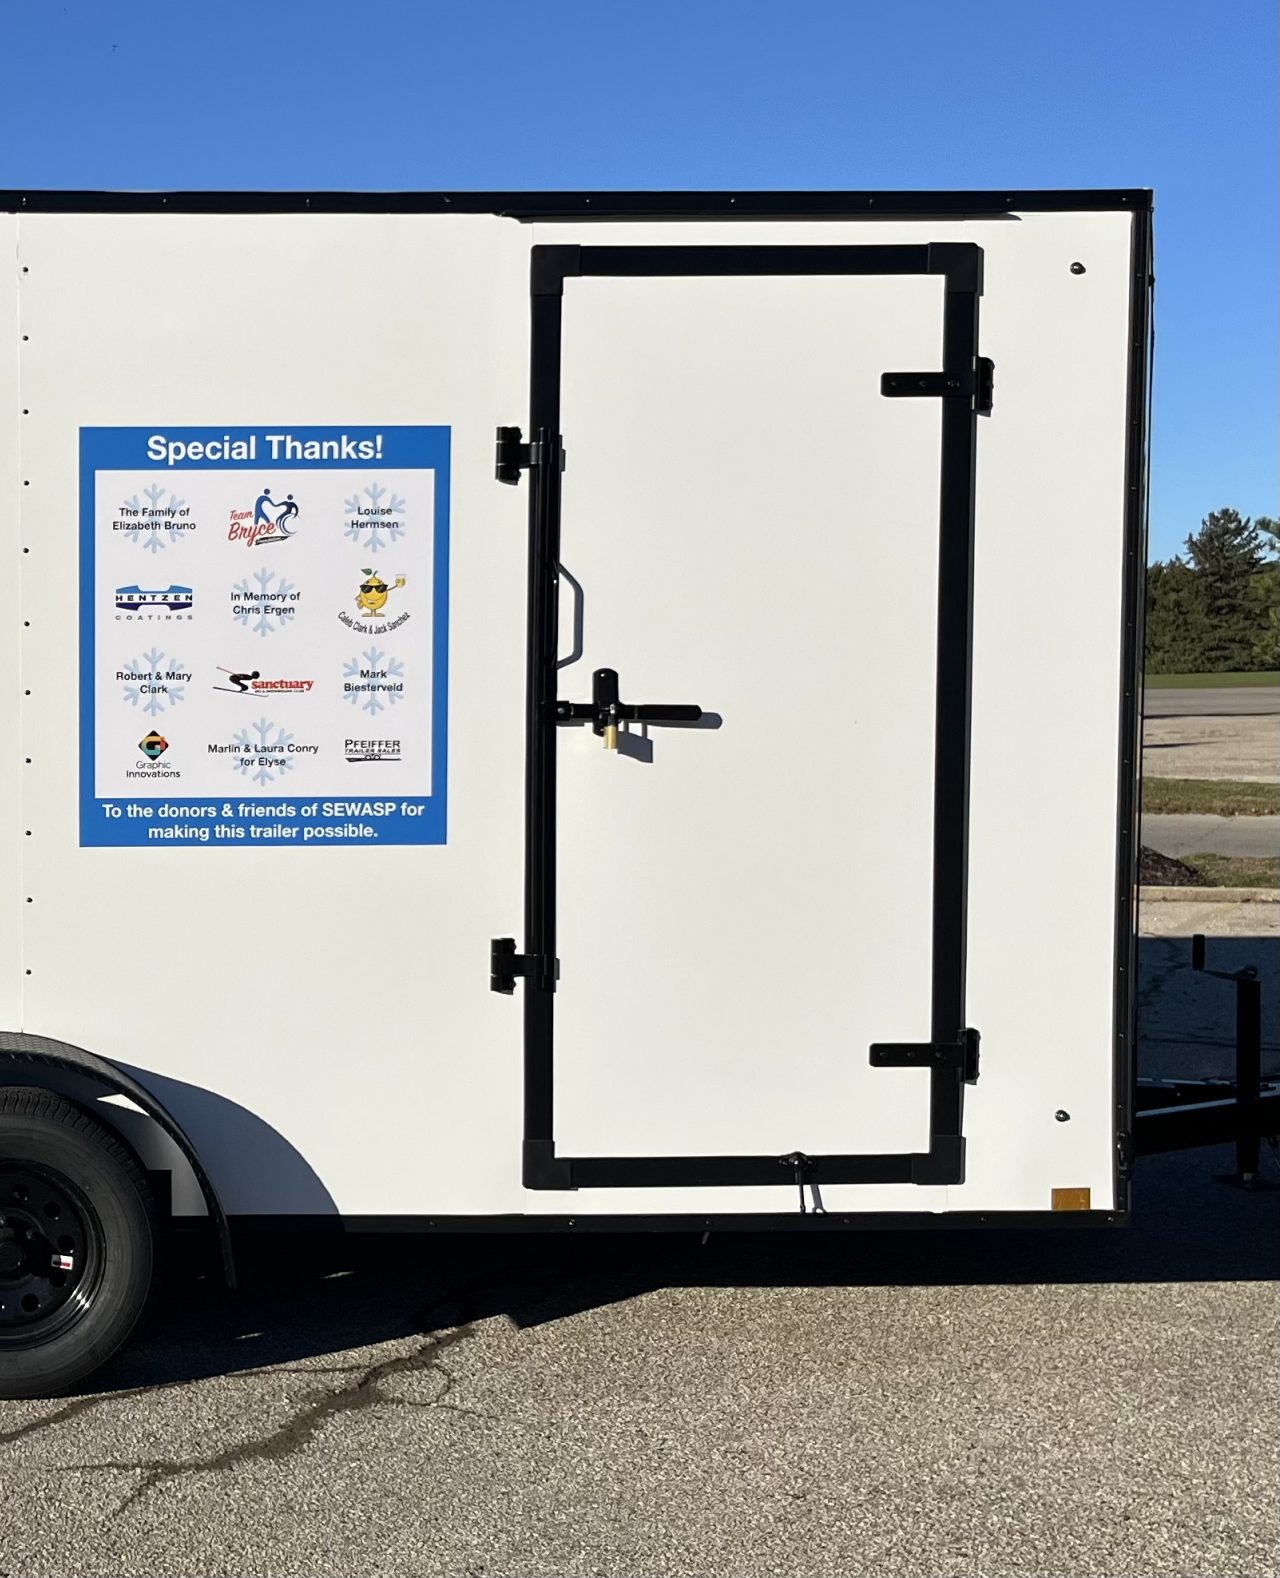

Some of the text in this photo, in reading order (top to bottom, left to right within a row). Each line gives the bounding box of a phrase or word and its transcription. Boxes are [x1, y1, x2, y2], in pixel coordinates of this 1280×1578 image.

[147, 436, 383, 465] Special Thanks!
[119, 507, 190, 518] The Family of
[229, 510, 254, 521] Team
[357, 506, 393, 515] Louise
[112, 521, 197, 530] Elizabeth Bruno
[351, 520, 399, 529] Hermsen
[228, 522, 276, 547] Bryce
[230, 592, 301, 602] In Memory of
[233, 605, 295, 616] Chris Ergen
[116, 672, 192, 682] Robert & Mary
[360, 670, 387, 678] Mark
[140, 685, 168, 693] Clark
[251, 679, 314, 690] sanctuary
[345, 739, 400, 748] PFEIFFER
[207, 744, 319, 754] Marlin & Laura Conry
[135, 760, 171, 770] Graphic
[240, 757, 286, 767] for Elyse
[126, 770, 181, 778] Innovations
[102, 802, 425, 818] To the donors & friends of SEWASP for
[148, 823, 379, 842] making this trailer possible.
